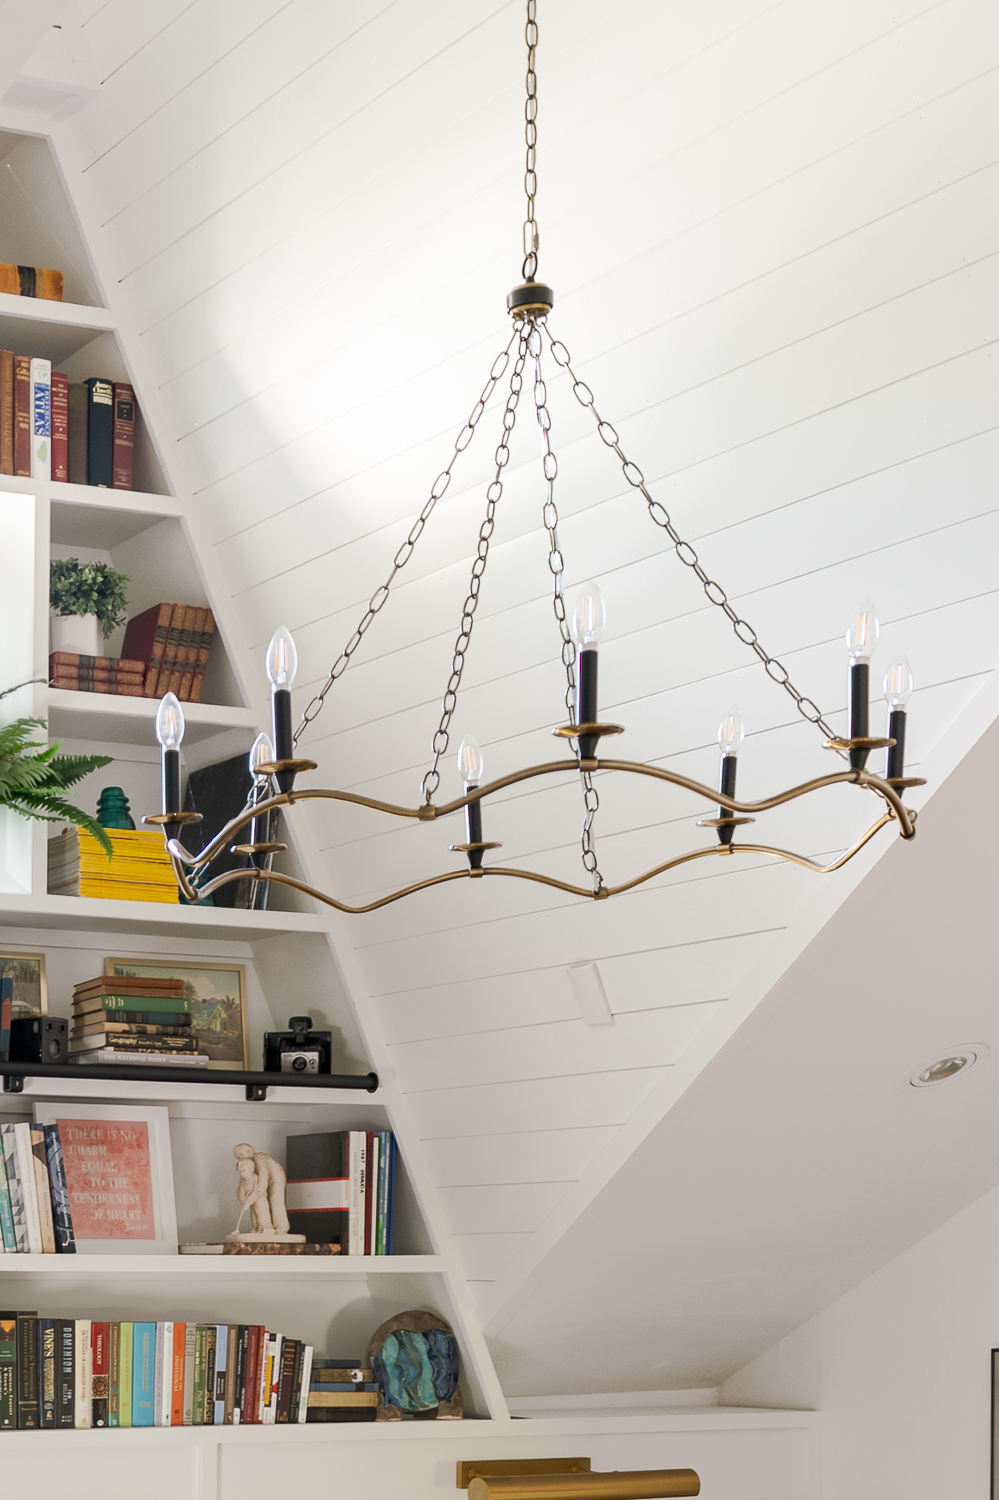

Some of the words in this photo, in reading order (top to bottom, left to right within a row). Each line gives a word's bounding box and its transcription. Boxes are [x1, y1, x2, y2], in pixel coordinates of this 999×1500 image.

[34, 389, 45, 435] ATLAS
[66, 1128, 105, 1141] THERE
[107, 1130, 116, 1140] IS
[120, 1131, 136, 1141] NO
[68, 1145, 107, 1156] CHARM
[81, 1161, 118, 1173] EQUAL
[90, 1176, 105, 1187] TO
[108, 1177, 129, 1189] THE
[73, 1193, 141, 1205] TENDERNESS
[90, 1209, 103, 1220] OF
[107, 1209, 141, 1220] HEART
[44, 1328, 54, 1357] VINE'S
[63, 1327, 72, 1373] DOMINION
